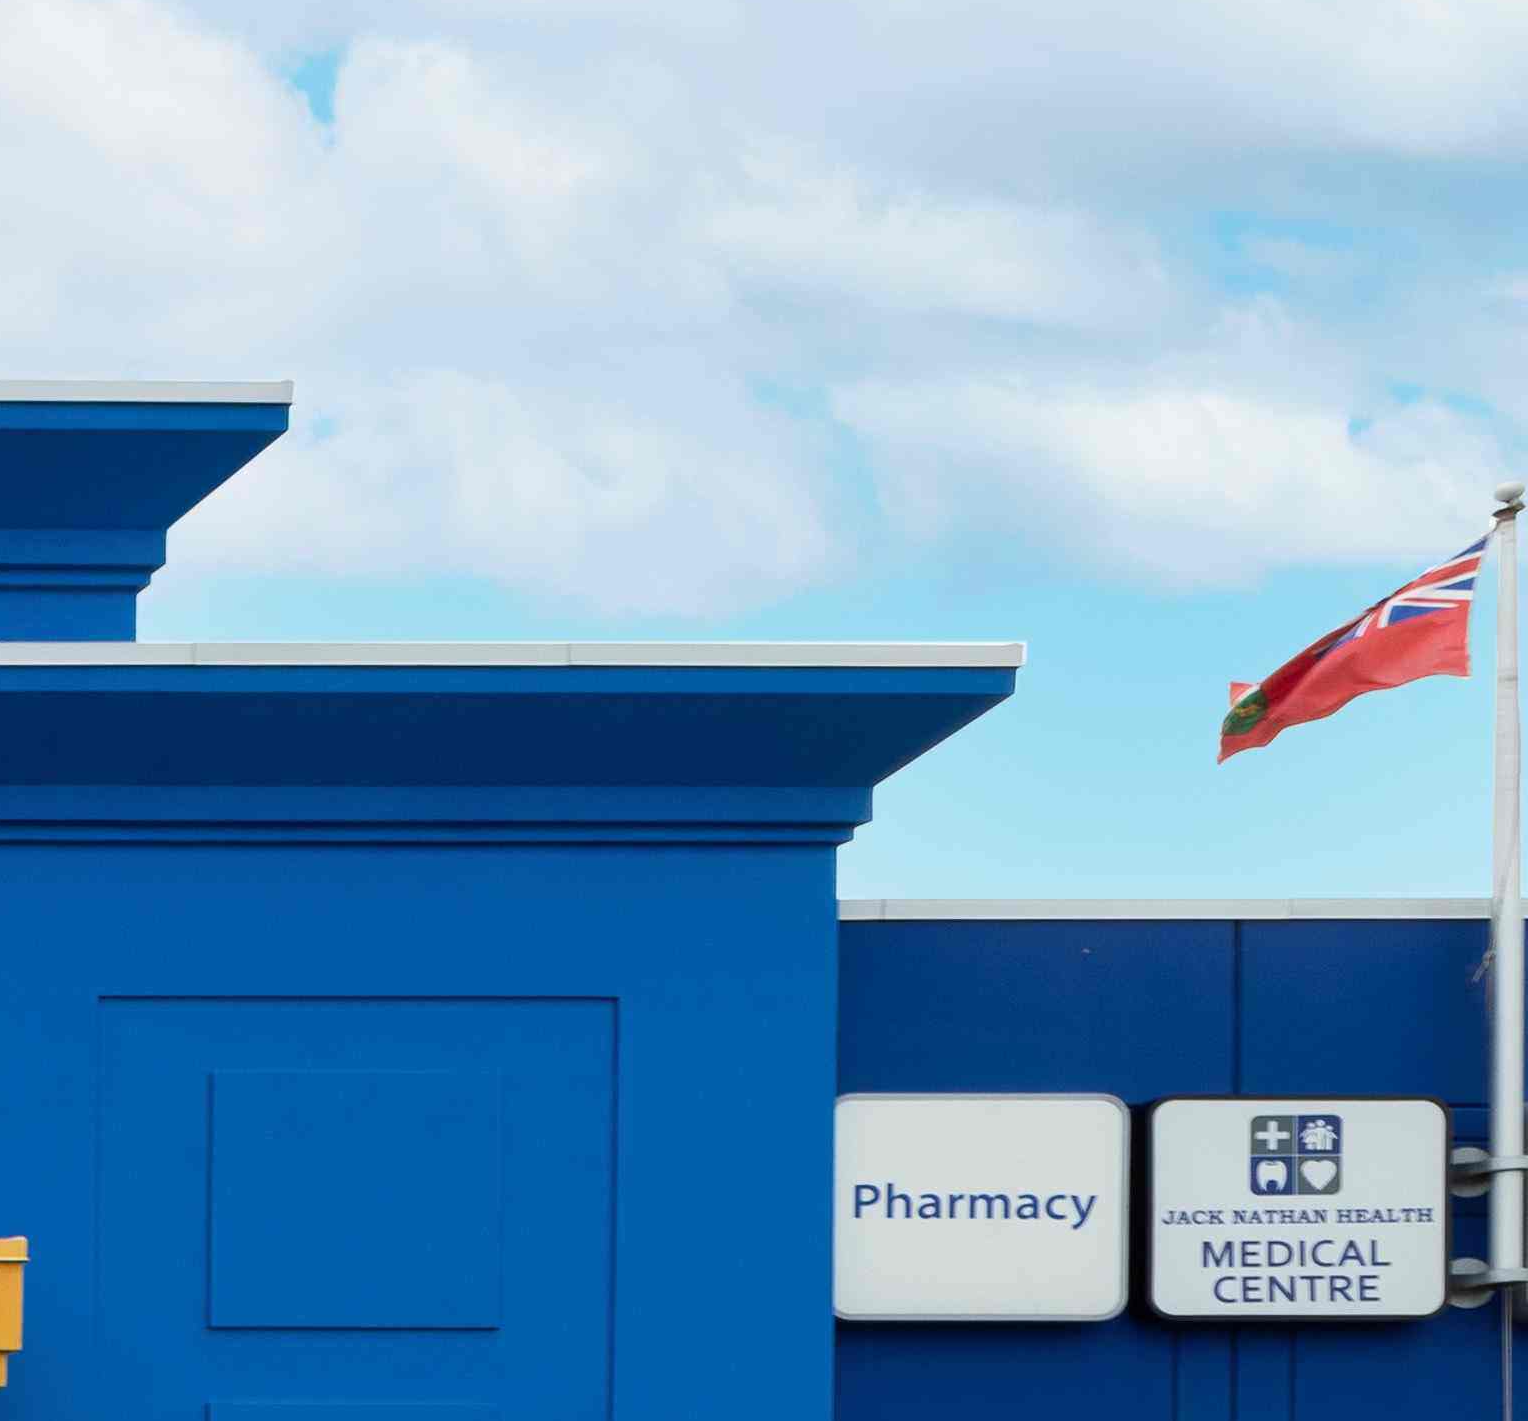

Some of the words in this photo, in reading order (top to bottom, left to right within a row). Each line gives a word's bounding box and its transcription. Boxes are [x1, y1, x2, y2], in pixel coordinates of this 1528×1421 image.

[853, 1183, 1096, 1230] Pharmacy
[1162, 1208, 1224, 1226] JACK
[1233, 1208, 1327, 1225] NATHAN
[1336, 1207, 1434, 1224] HEALTH
[1202, 1239, 1391, 1268] MEDICAL
[1213, 1274, 1381, 1304] CENTRE
